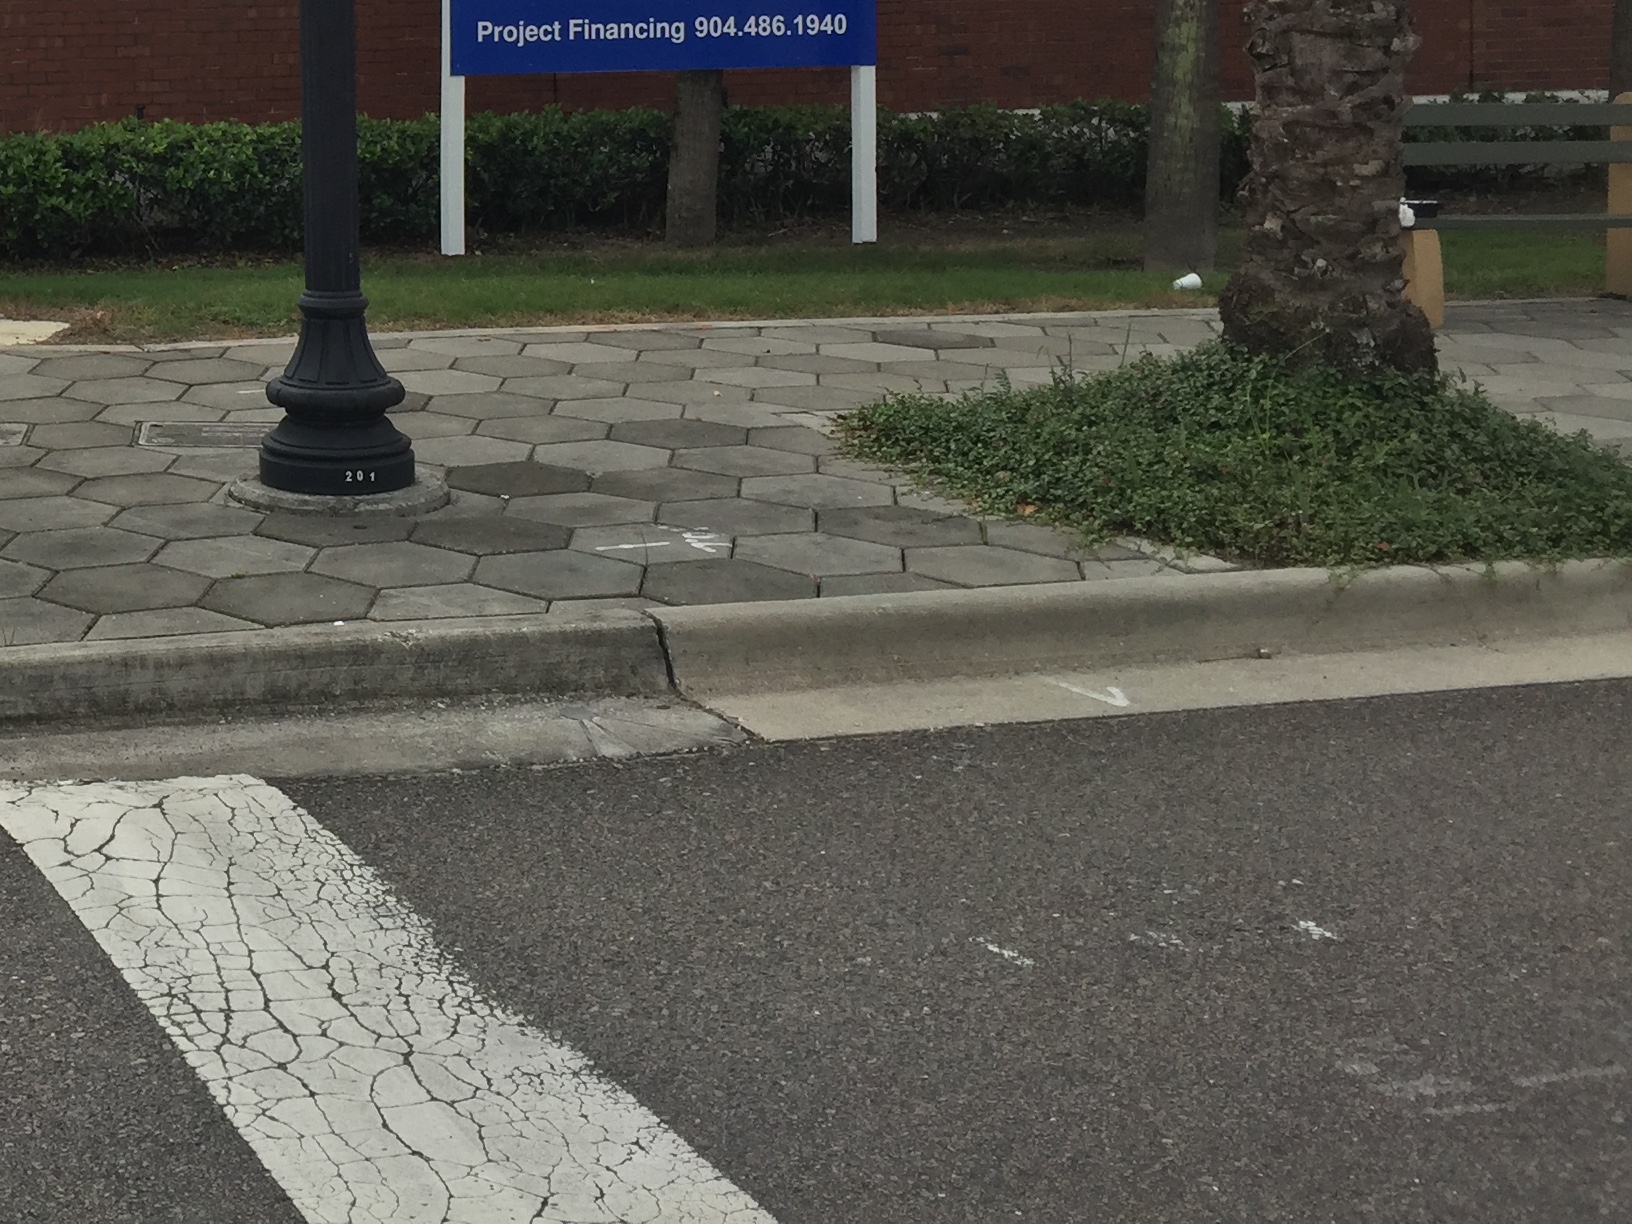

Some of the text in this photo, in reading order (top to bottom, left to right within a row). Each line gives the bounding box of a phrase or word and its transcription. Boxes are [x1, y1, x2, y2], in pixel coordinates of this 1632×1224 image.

[477, 13, 848, 48] Project Financing 904.486.1940
[344, 470, 376, 482] 201
